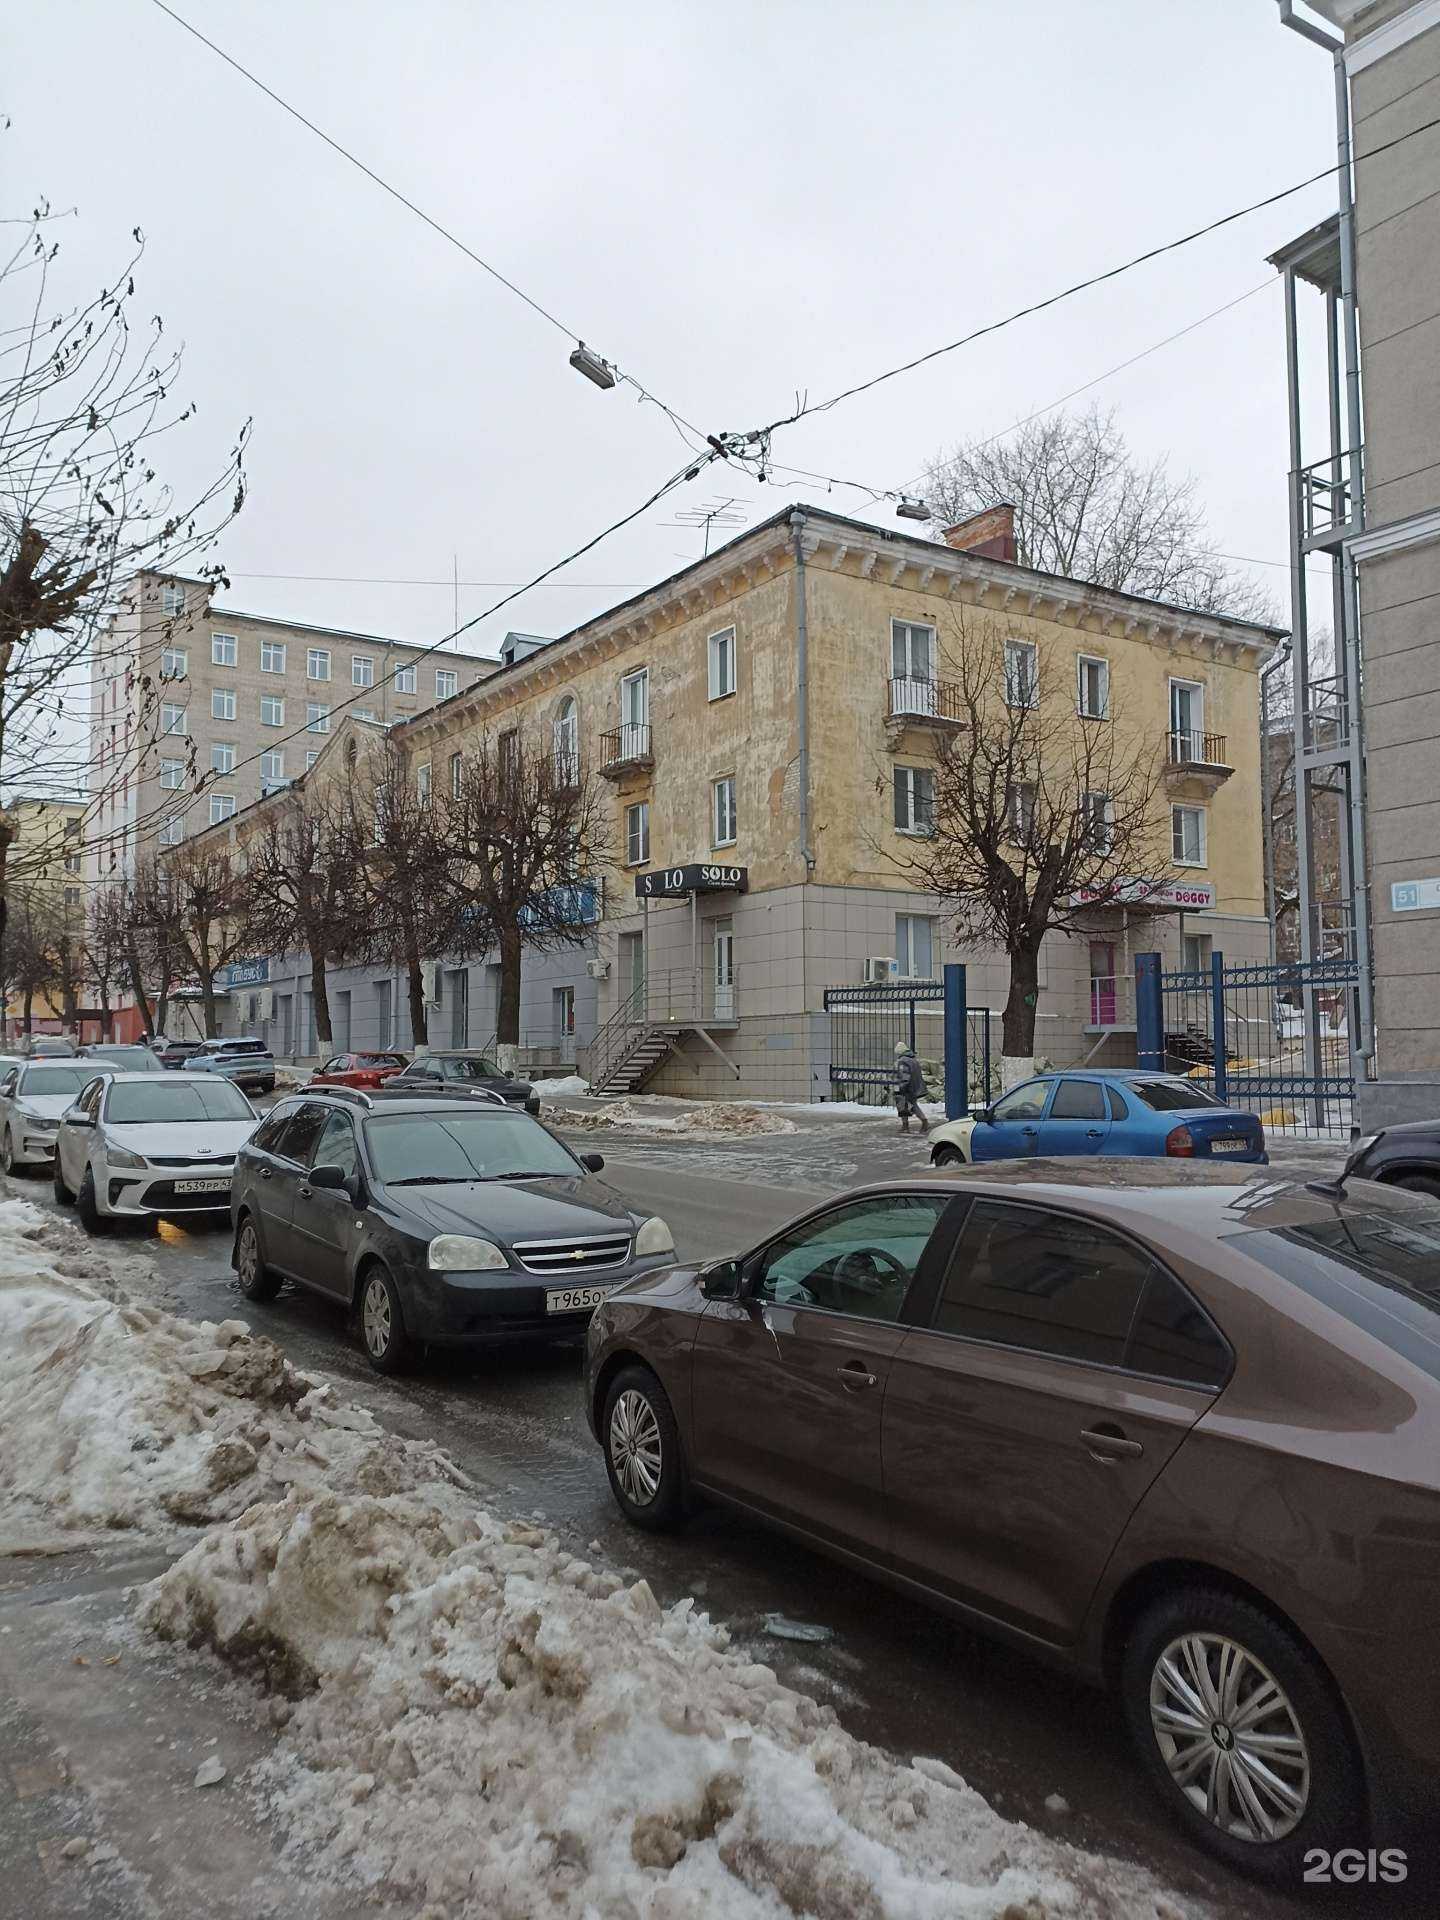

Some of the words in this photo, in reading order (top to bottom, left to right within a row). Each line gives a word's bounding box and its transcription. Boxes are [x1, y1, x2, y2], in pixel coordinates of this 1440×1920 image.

[701, 866, 741, 882] SOLO
[1175, 890, 1211, 905] DOGGY
[1397, 889, 1416, 903] 51
[552, 1289, 606, 1310] Т965О
